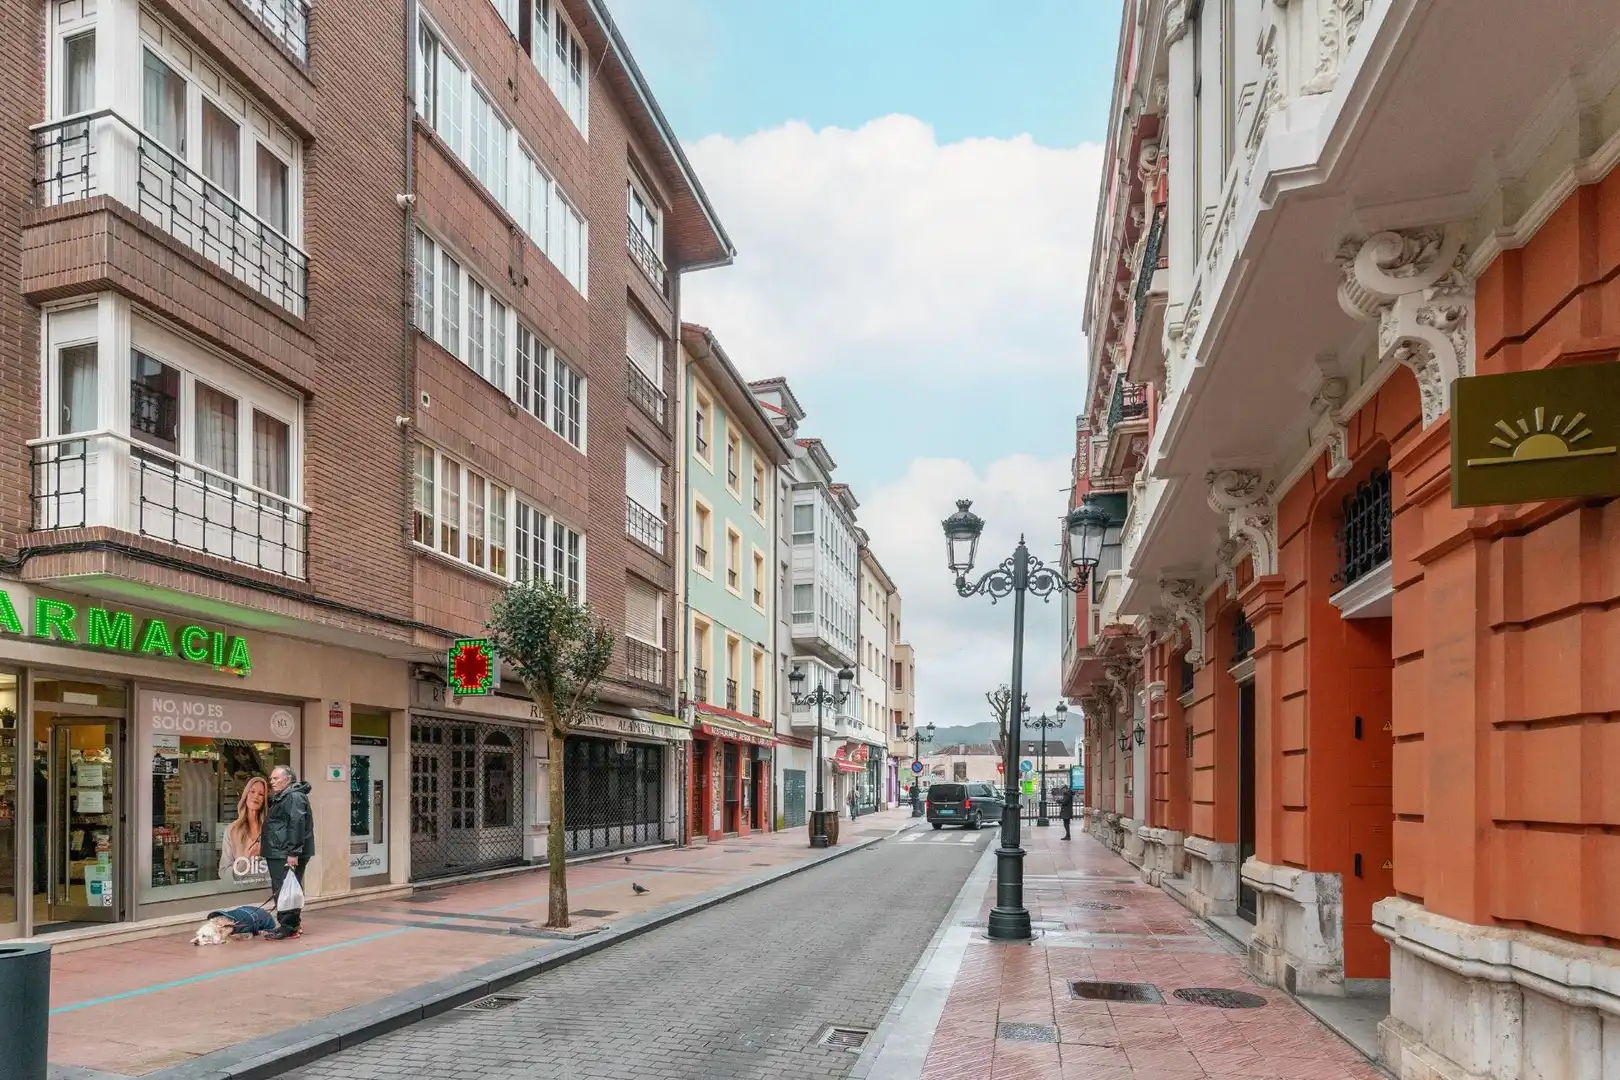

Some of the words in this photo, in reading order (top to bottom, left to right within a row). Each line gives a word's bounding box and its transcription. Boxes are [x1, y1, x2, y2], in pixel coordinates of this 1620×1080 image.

[183, 701, 205, 716] NO
[208, 704, 223, 717] ES
[152, 715, 195, 731] SOLO
[198, 719, 232, 734] PELO
